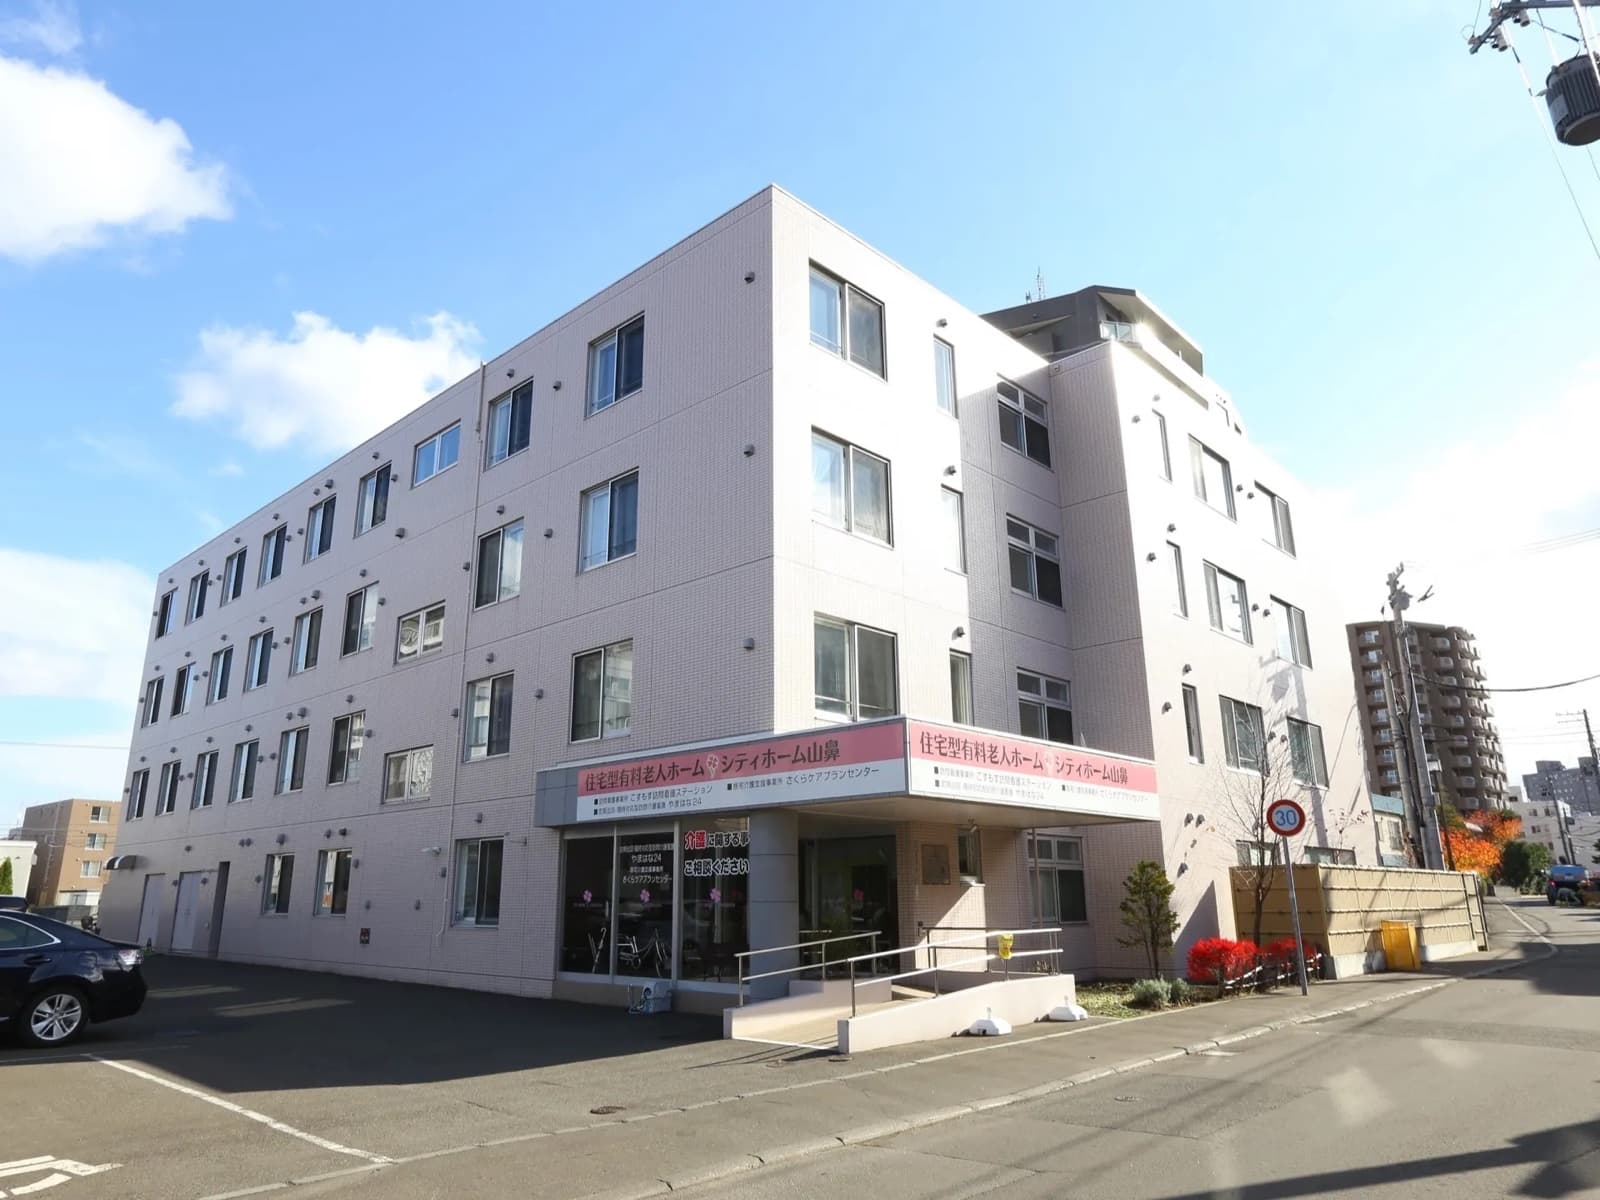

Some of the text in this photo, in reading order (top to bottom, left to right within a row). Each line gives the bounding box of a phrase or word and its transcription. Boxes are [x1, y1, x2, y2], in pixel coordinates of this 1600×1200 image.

[585, 739, 841, 792] 住宅型有料老人ホーム シティホーム山鼻
[920, 731, 1128, 785] 住宅型有料老人ホーム シティホーム山鼻
[786, 766, 880, 786] さくらケアプランセンター
[1275, 809, 1297, 826] 30
[684, 857, 750, 877] ご相談ください
